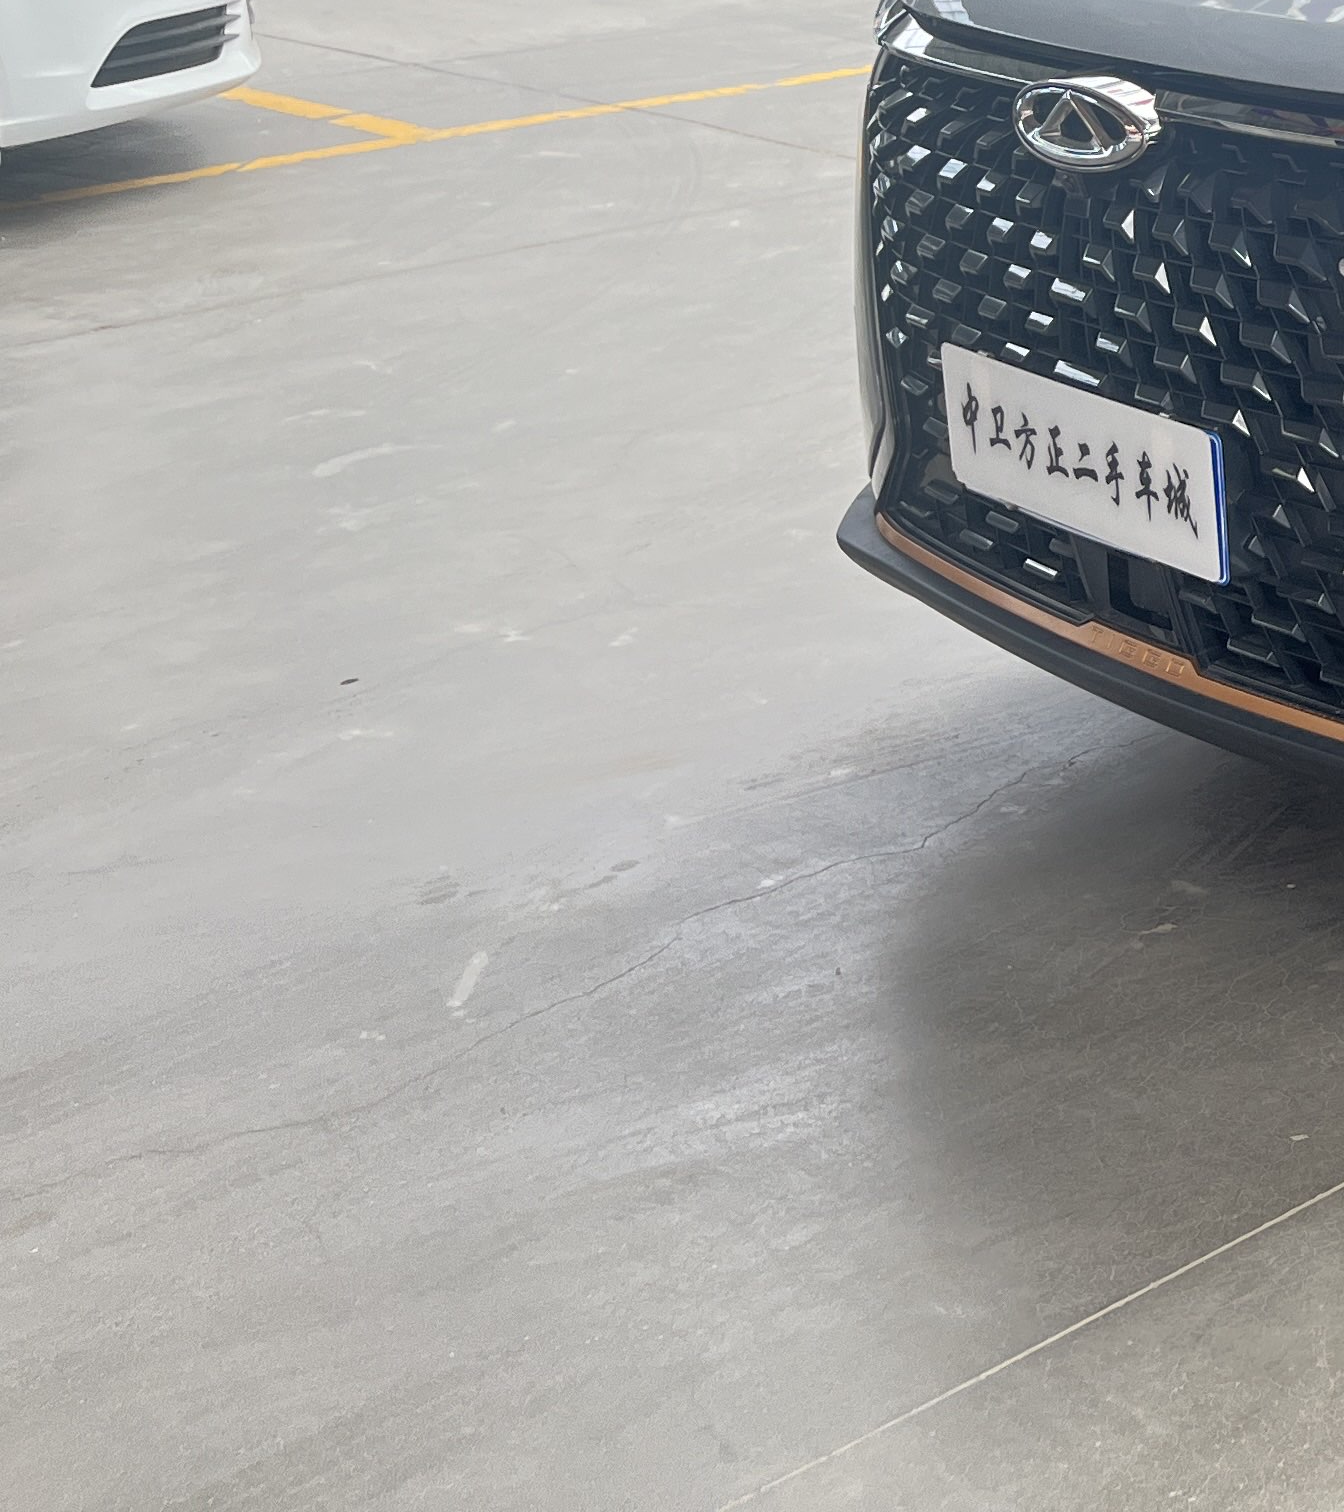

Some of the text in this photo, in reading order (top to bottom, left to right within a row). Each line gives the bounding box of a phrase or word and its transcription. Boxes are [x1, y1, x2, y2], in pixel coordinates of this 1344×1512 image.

[960, 381, 1199, 540] 中卫方正二手车城
[1091, 623, 1185, 678] TIGGO
